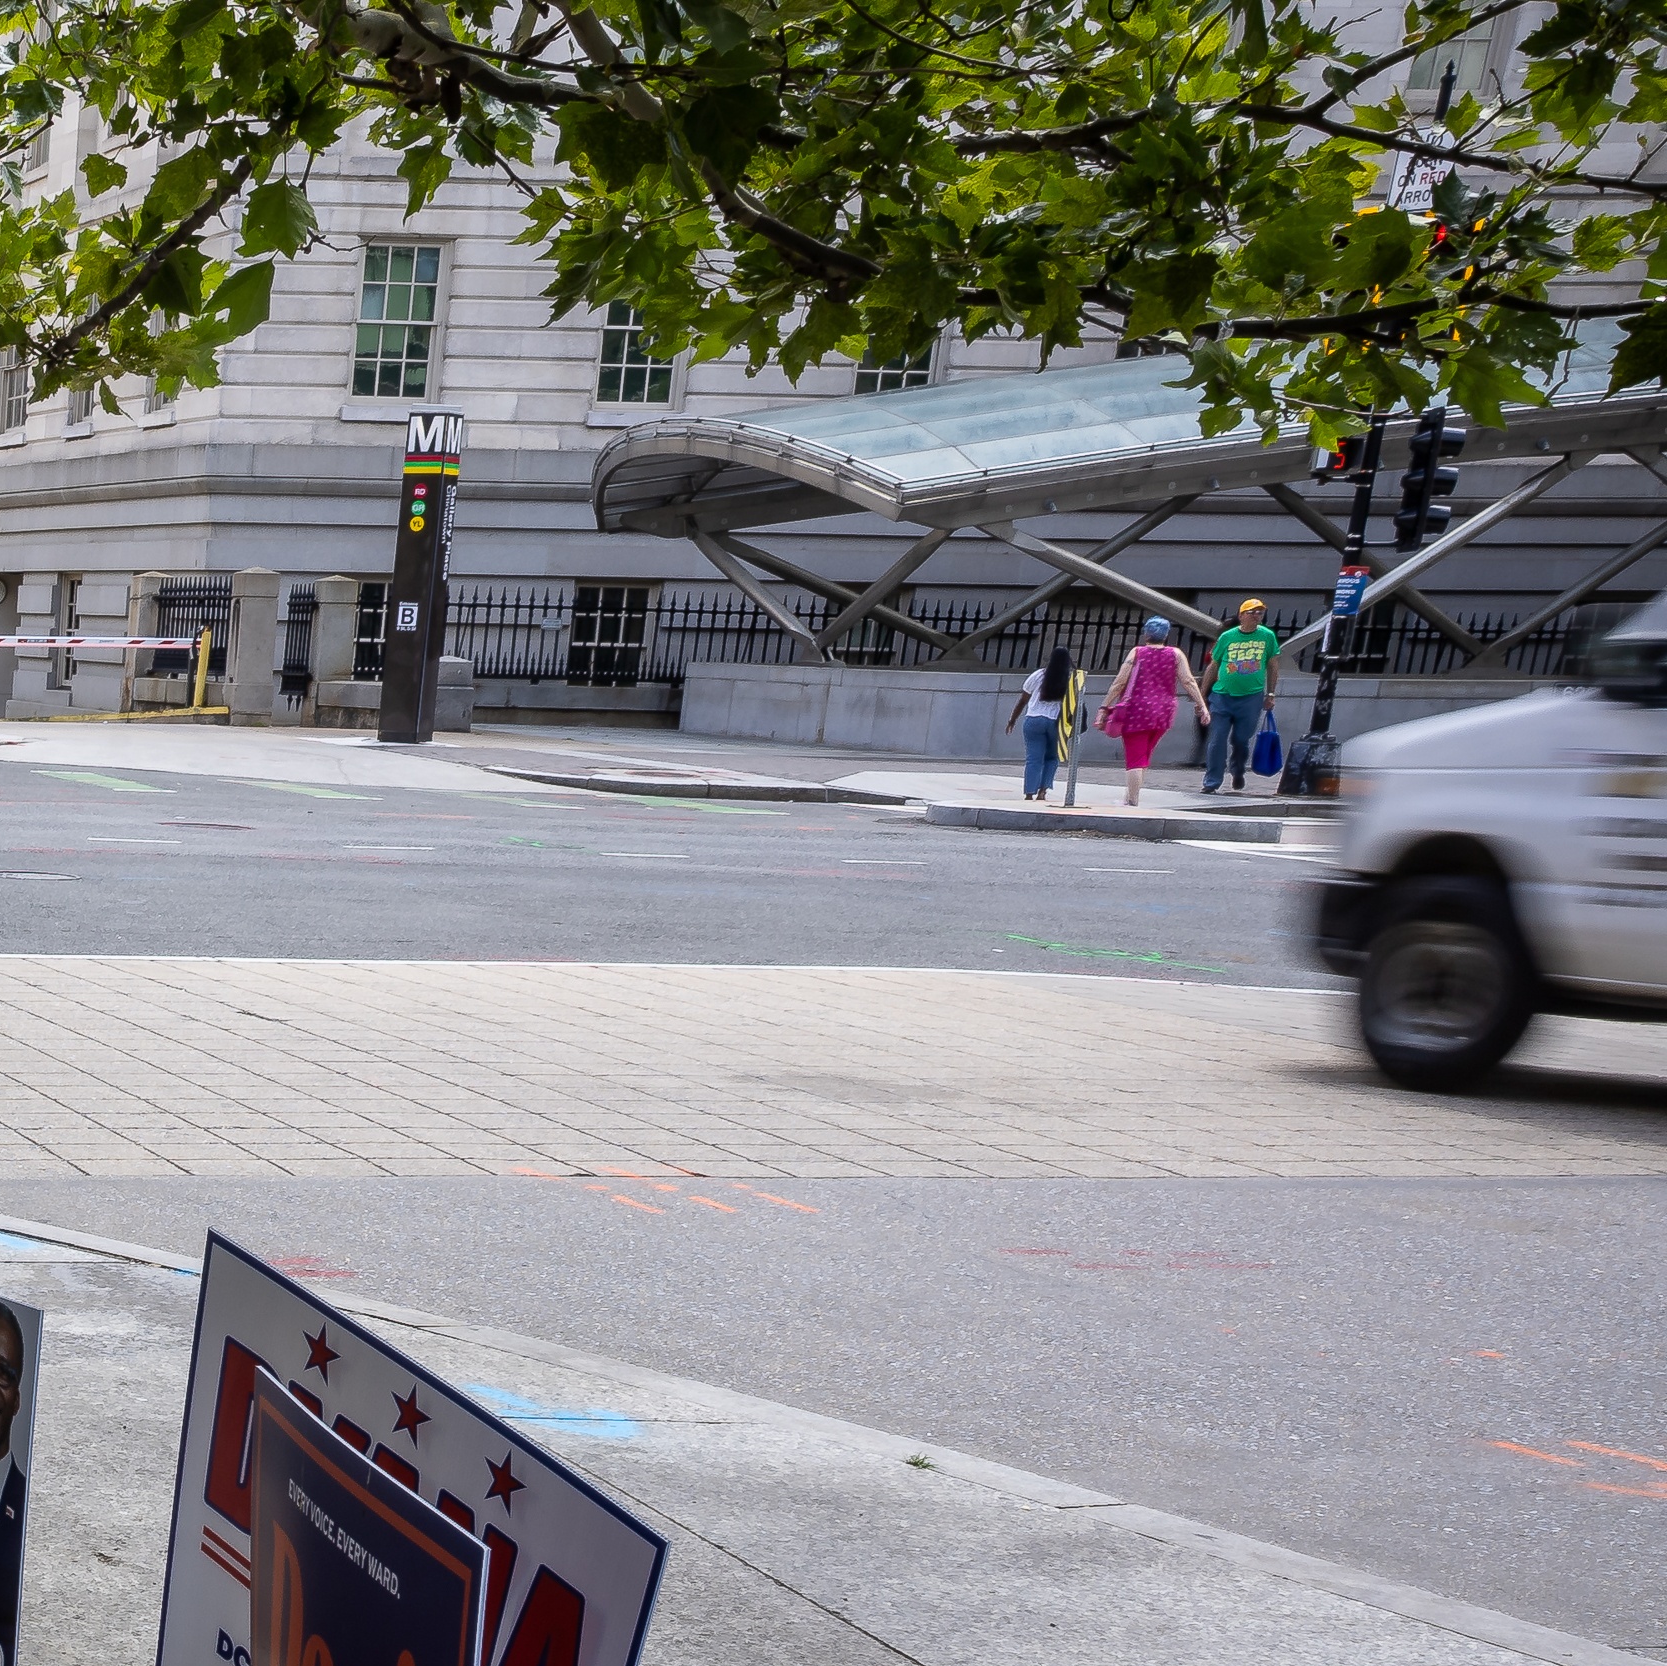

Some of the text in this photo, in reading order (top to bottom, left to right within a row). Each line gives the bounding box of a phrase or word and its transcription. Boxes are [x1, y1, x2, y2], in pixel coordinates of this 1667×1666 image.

[1419, 171, 1446, 185] RED
[407, 415, 464, 454] M M
[412, 520, 422, 529] YL
[442, 485, 457, 581] Gallery Place
[401, 608, 415, 625] B
[1227, 649, 1264, 662] FEST
[288, 1477, 402, 1601] EVERY VOICE. EVERY WARD.
